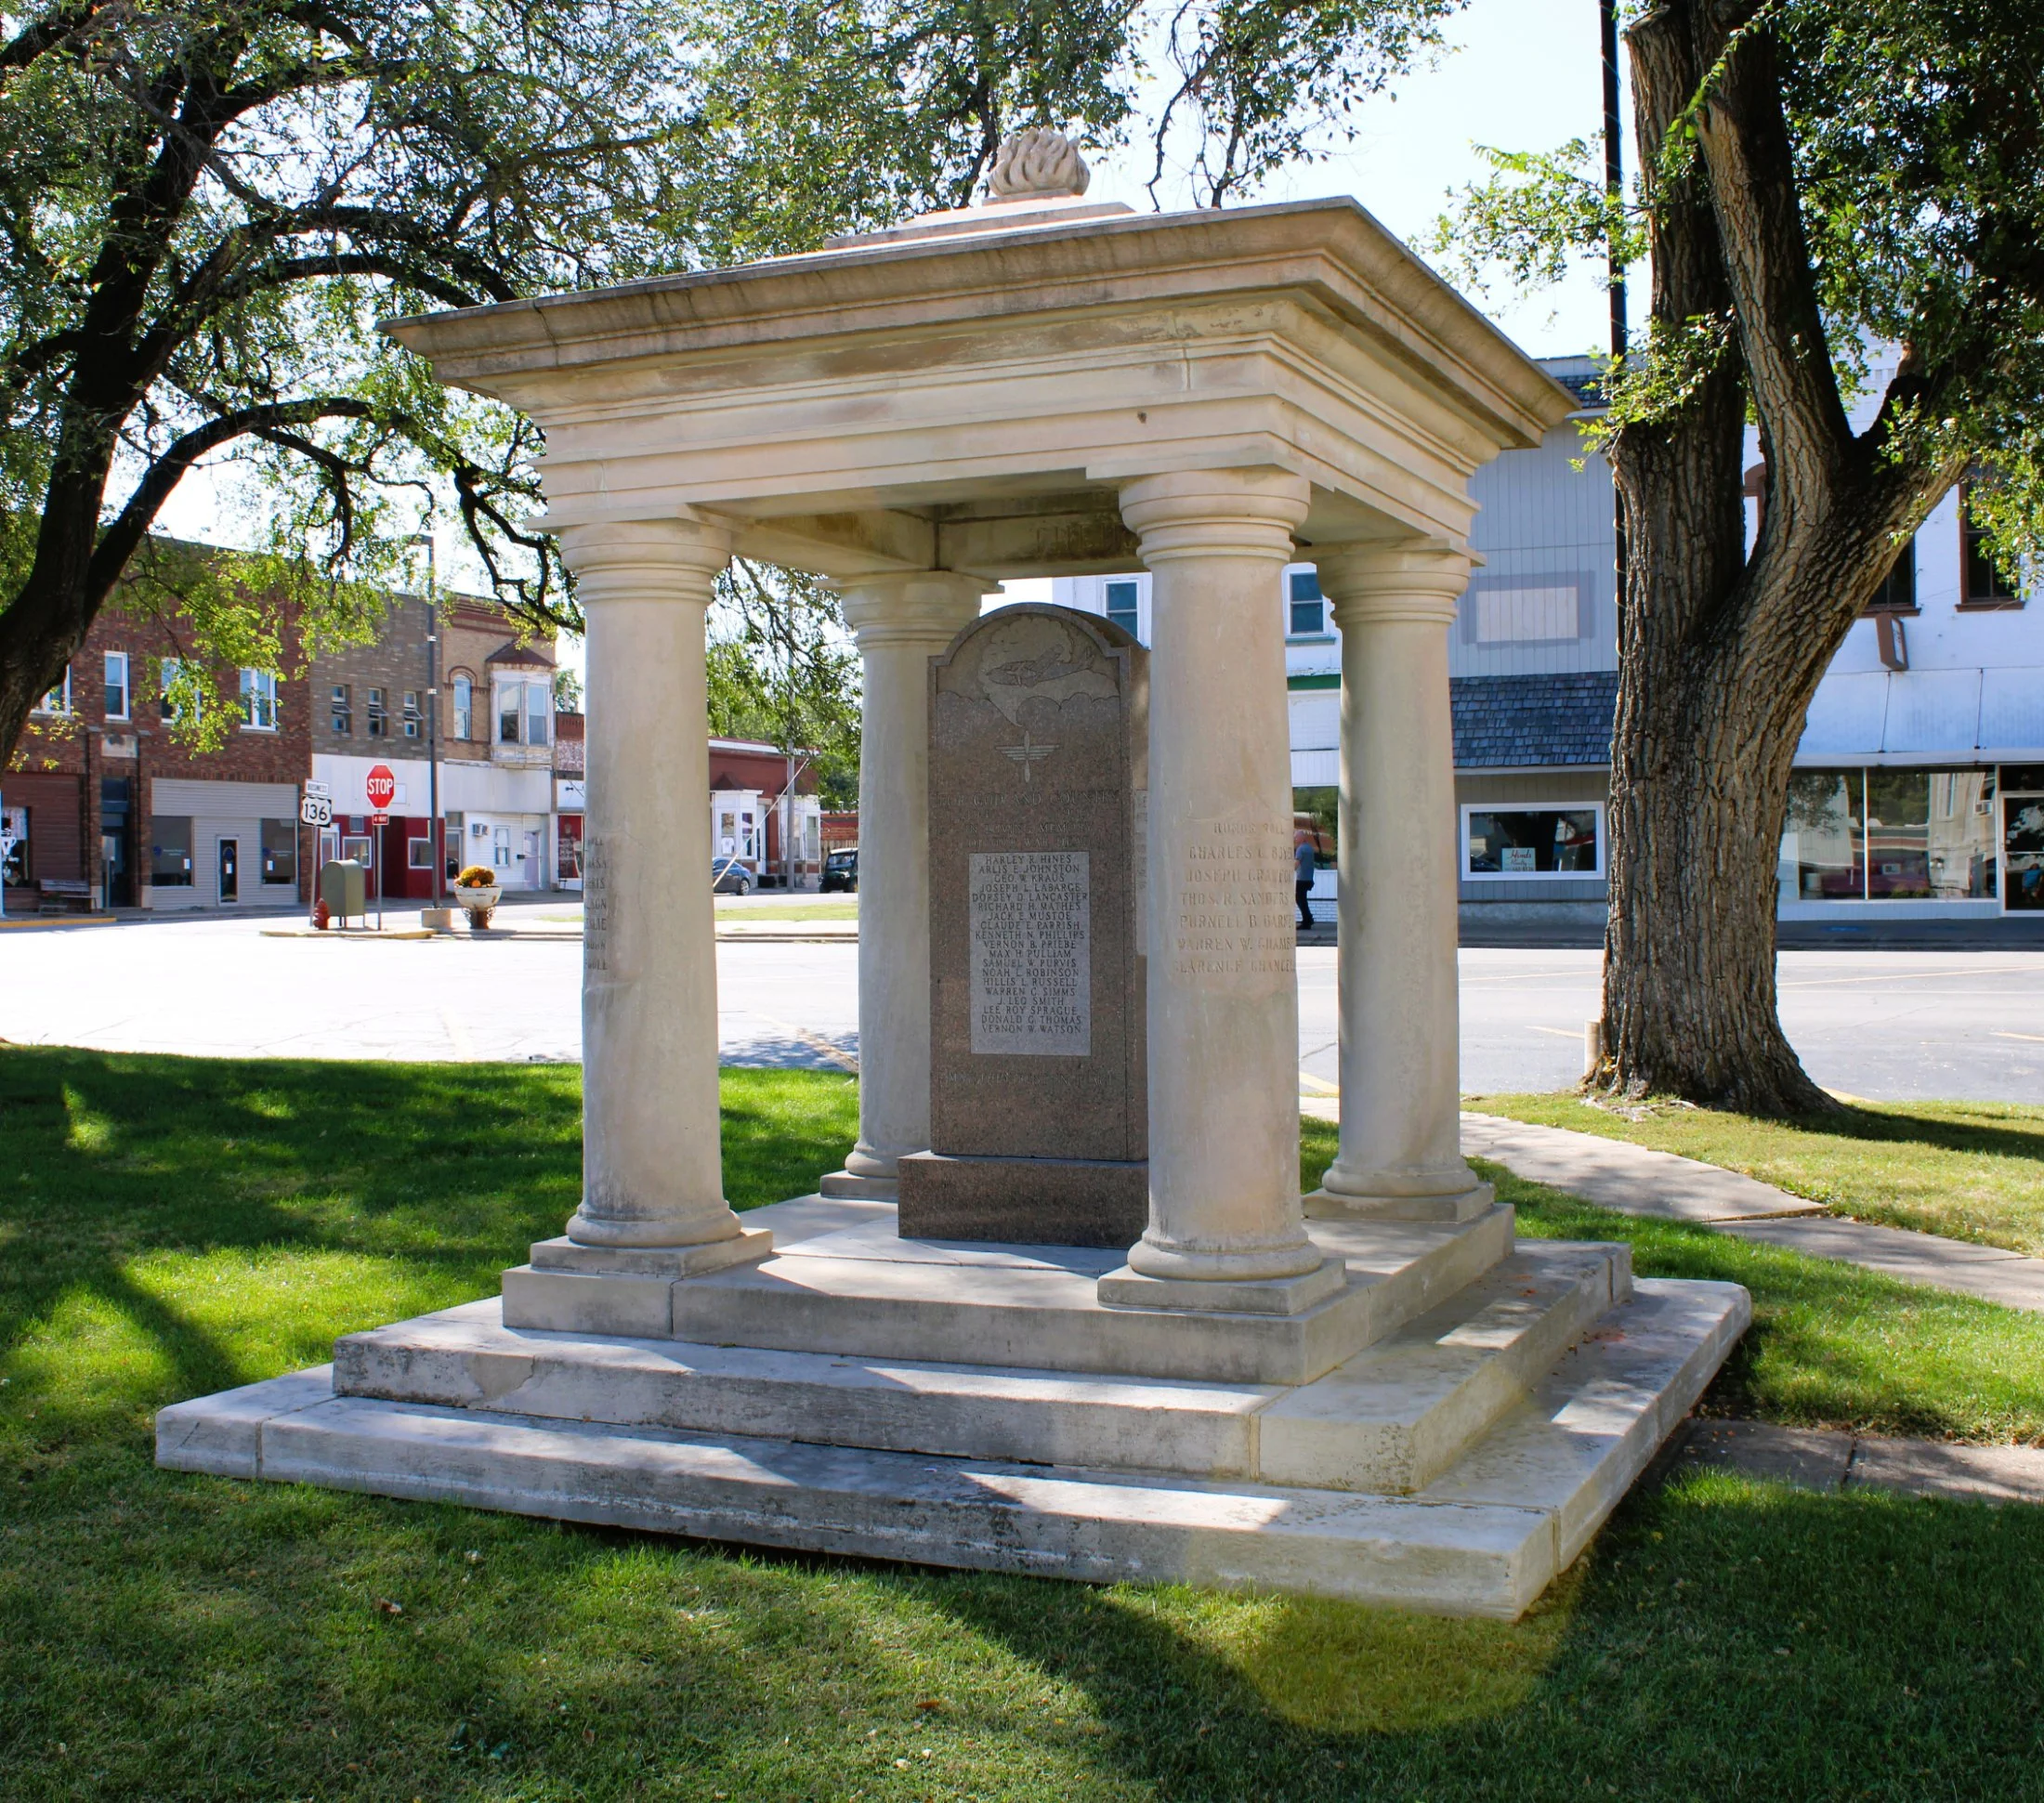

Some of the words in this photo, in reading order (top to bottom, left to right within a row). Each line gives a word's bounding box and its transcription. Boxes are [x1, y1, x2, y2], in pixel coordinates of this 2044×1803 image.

[368, 778, 393, 794] STOP
[1014, 792, 1042, 806] AND
[305, 804, 327, 821] 136
[1189, 846, 1252, 860] CHARLES
[985, 855, 1024, 866] HARLEY
[1041, 854, 1072, 864] HINES
[979, 865, 1008, 874] ARLIS
[1024, 864, 1080, 874] JOHNSTON
[1031, 873, 1066, 882] KRAUS
[1186, 869, 1240, 882] JOSEPH
[980, 884, 1018, 894] JOSEPH
[1034, 883, 1081, 893] LABARGE
[972, 894, 1013, 903] DORSEY
[1029, 892, 1088, 902] LANCASTER
[978, 903, 1023, 912] RICHARD
[1041, 901, 1081, 911] MATHES
[987, 912, 1015, 921] JACK
[1029, 911, 1071, 921] MUSTOE
[980, 921, 1022, 931] CLAUDE
[1037, 921, 1080, 931] PARRISH
[1180, 915, 1239, 929] PURNELL
[976, 931, 1021, 940] KENNETH
[1040, 930, 1085, 940] PHILLIPS
[983, 940, 1024, 949] VERNON
[1041, 939, 1077, 949] PRIEBE
[1178, 936, 1233, 951] WARREN
[989, 949, 1011, 959] MAX
[1027, 948, 1071, 959] PULLIAM
[983, 959, 1023, 968] SAMUEL
[1040, 958, 1077, 968] PURVIS
[982, 968, 1011, 977] NOAH
[1026, 967, 1080, 977] ROBINSON
[983, 977, 1016, 986] HILLIS
[1031, 977, 1078, 986] RUSSELL
[985, 986, 1026, 997] WARREN
[1042, 986, 1076, 997] SIMMS
[1008, 996, 1028, 1006] LEO
[1032, 996, 1065, 1006] SMITH
[983, 1006, 1002, 1014] LEE
[1006, 1005, 1027, 1015] ROY
[1030, 1005, 1078, 1015] SPRAGUE
[981, 1014, 1023, 1025] DONALD
[1041, 1014, 1081, 1026] THOMAS
[982, 1024, 1023, 1034] VERNON
[1041, 1024, 1081, 1034] WATSON
